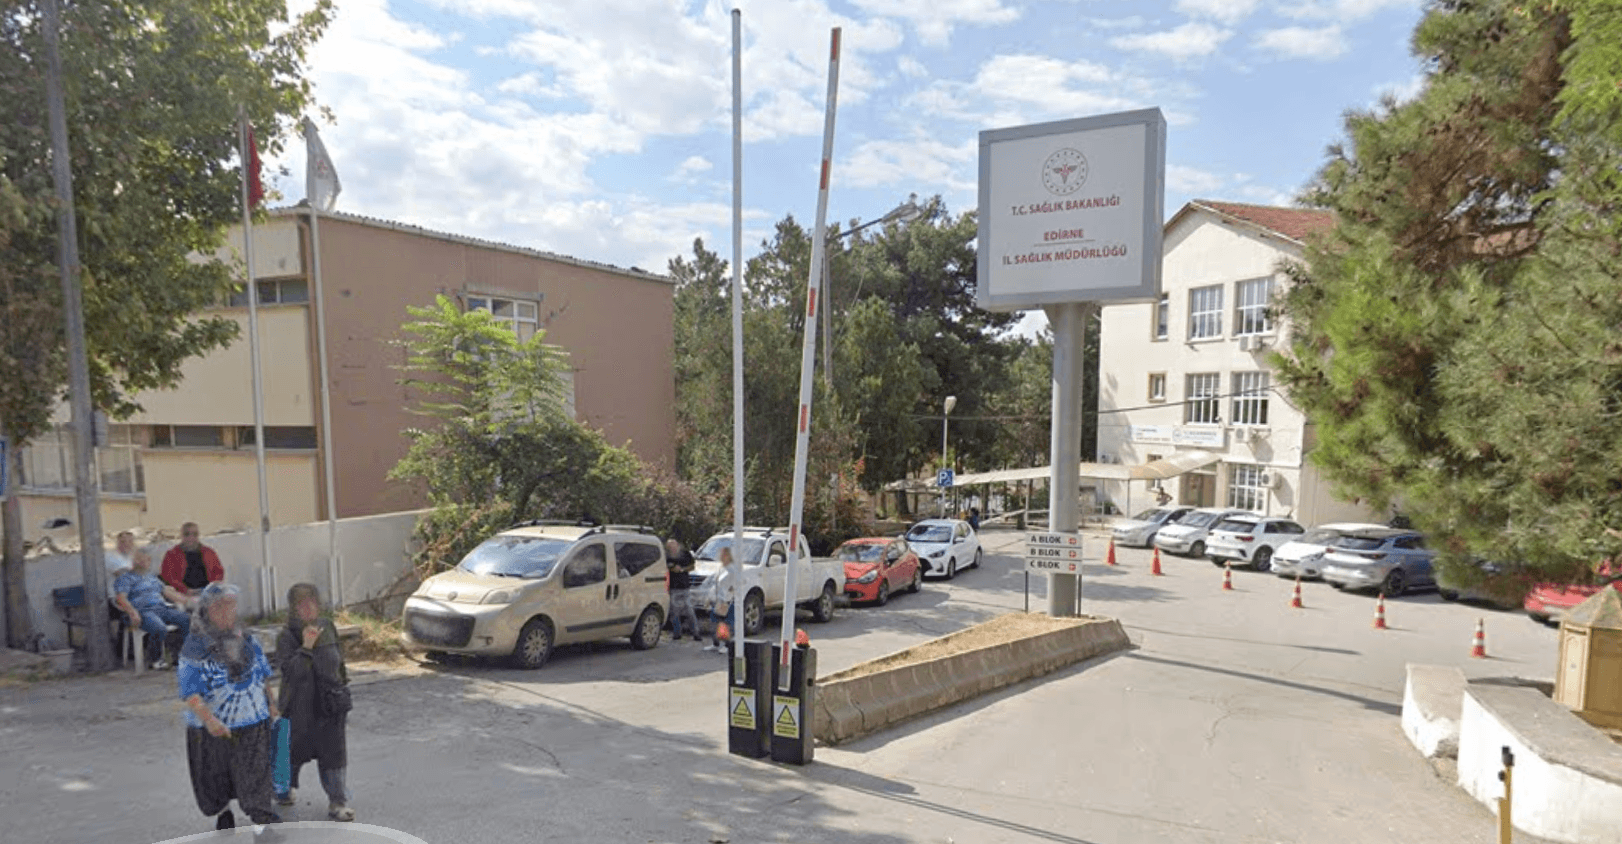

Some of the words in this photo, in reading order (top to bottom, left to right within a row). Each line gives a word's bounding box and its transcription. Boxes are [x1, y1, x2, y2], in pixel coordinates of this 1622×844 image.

[1011, 206, 1027, 216] T.C.
[1029, 201, 1063, 214] SAĞLIK
[1065, 195, 1120, 210] BAKANLIĞI
[1043, 229, 1083, 241] EDİRNE
[1014, 252, 1052, 264] SAĞLIK
[1054, 244, 1127, 261] MÜDÜRLÜĞÜ
[939, 472, 947, 484] P
[1031, 535, 1037, 543] A
[1038, 548, 1061, 556] BLOK
[1030, 560, 1035, 568] C
[1037, 561, 1060, 569] BLOK
